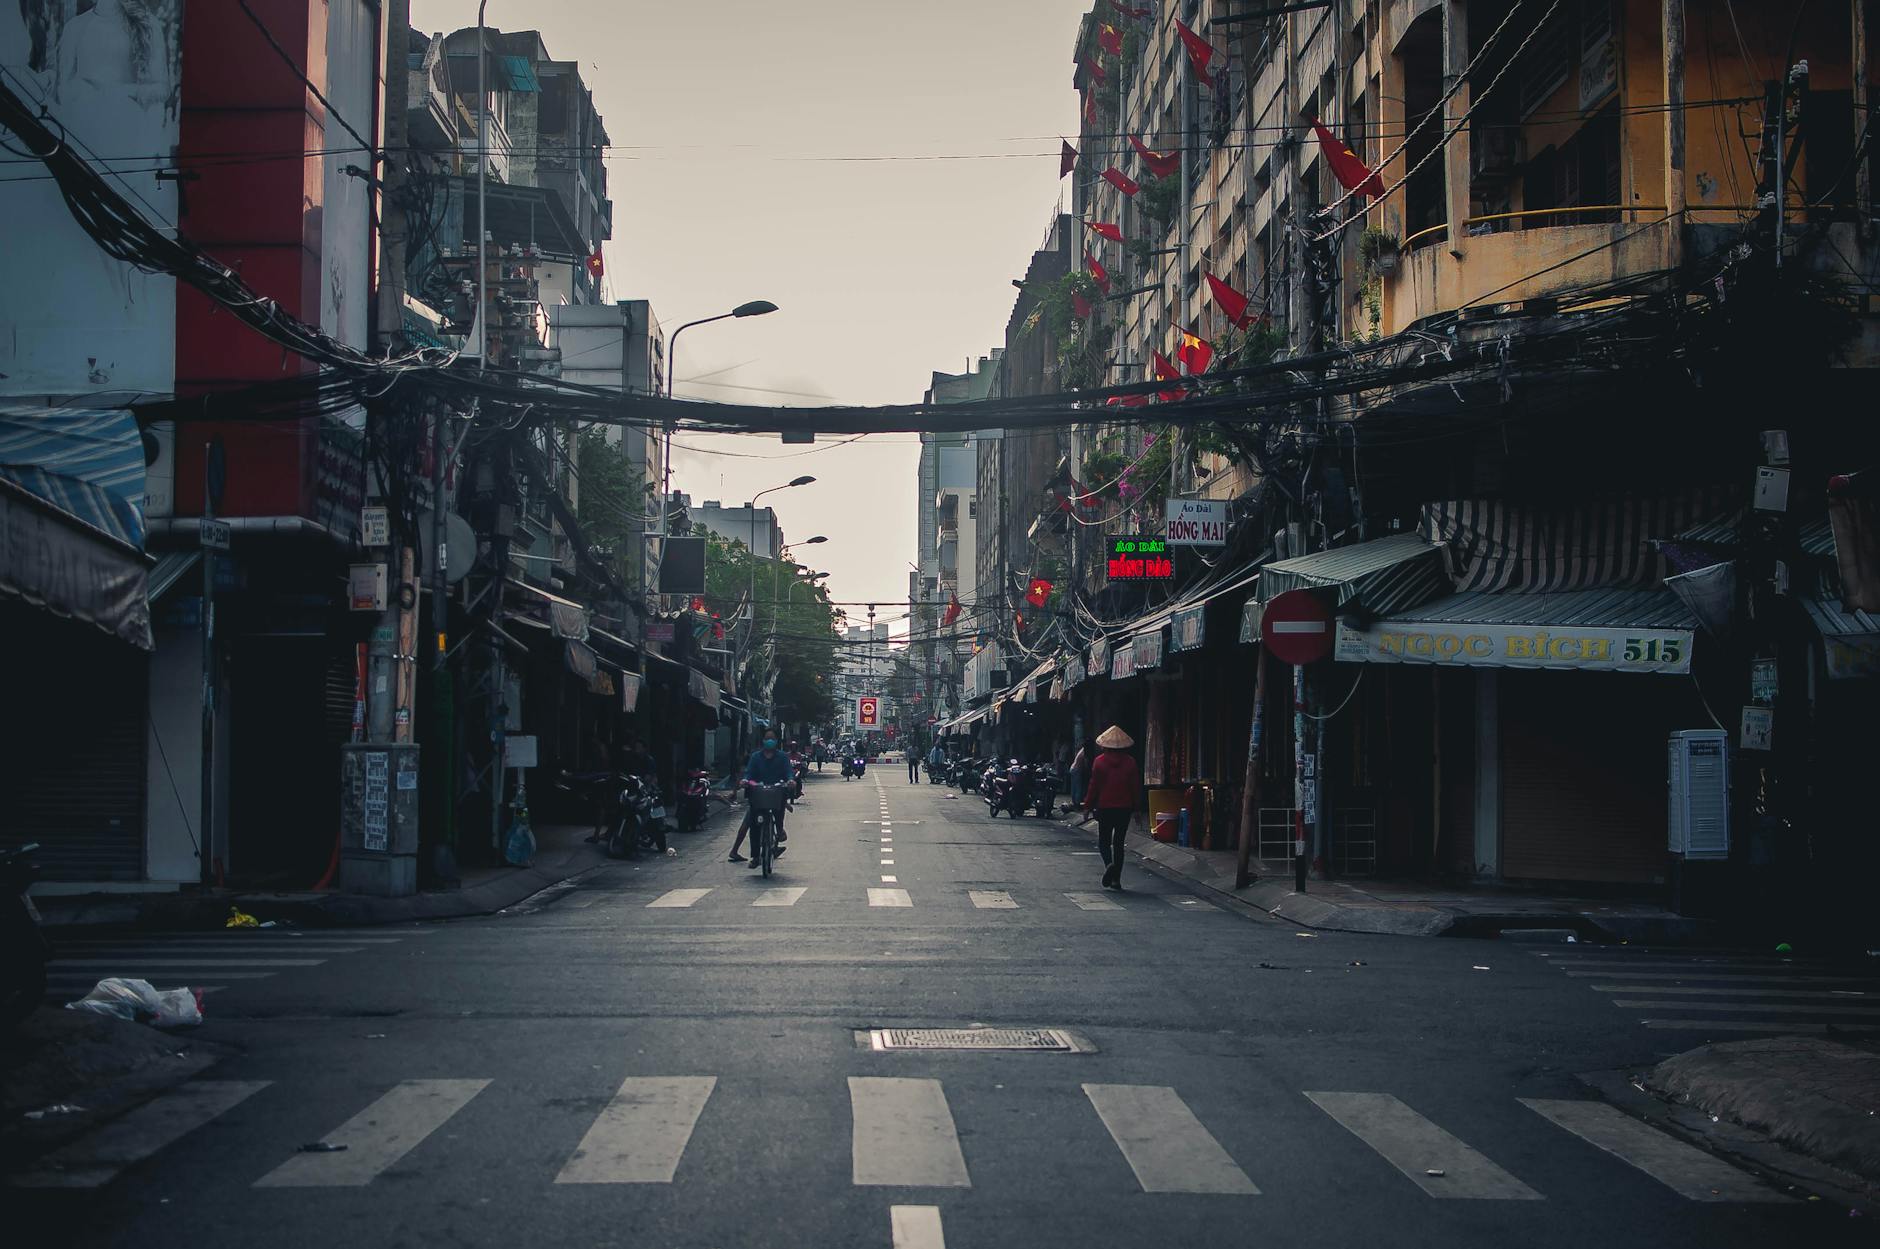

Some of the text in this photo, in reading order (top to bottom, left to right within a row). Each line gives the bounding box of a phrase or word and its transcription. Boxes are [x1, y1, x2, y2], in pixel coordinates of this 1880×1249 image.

[1181, 501, 1194, 513] Áo
[1168, 512, 1224, 541] HỒNG MAI
[1115, 540, 1136, 552] ÁO
[1379, 631, 1494, 662] NGỌC
[1504, 631, 1615, 661] BÍCH
[1624, 638, 1685, 663] 515
